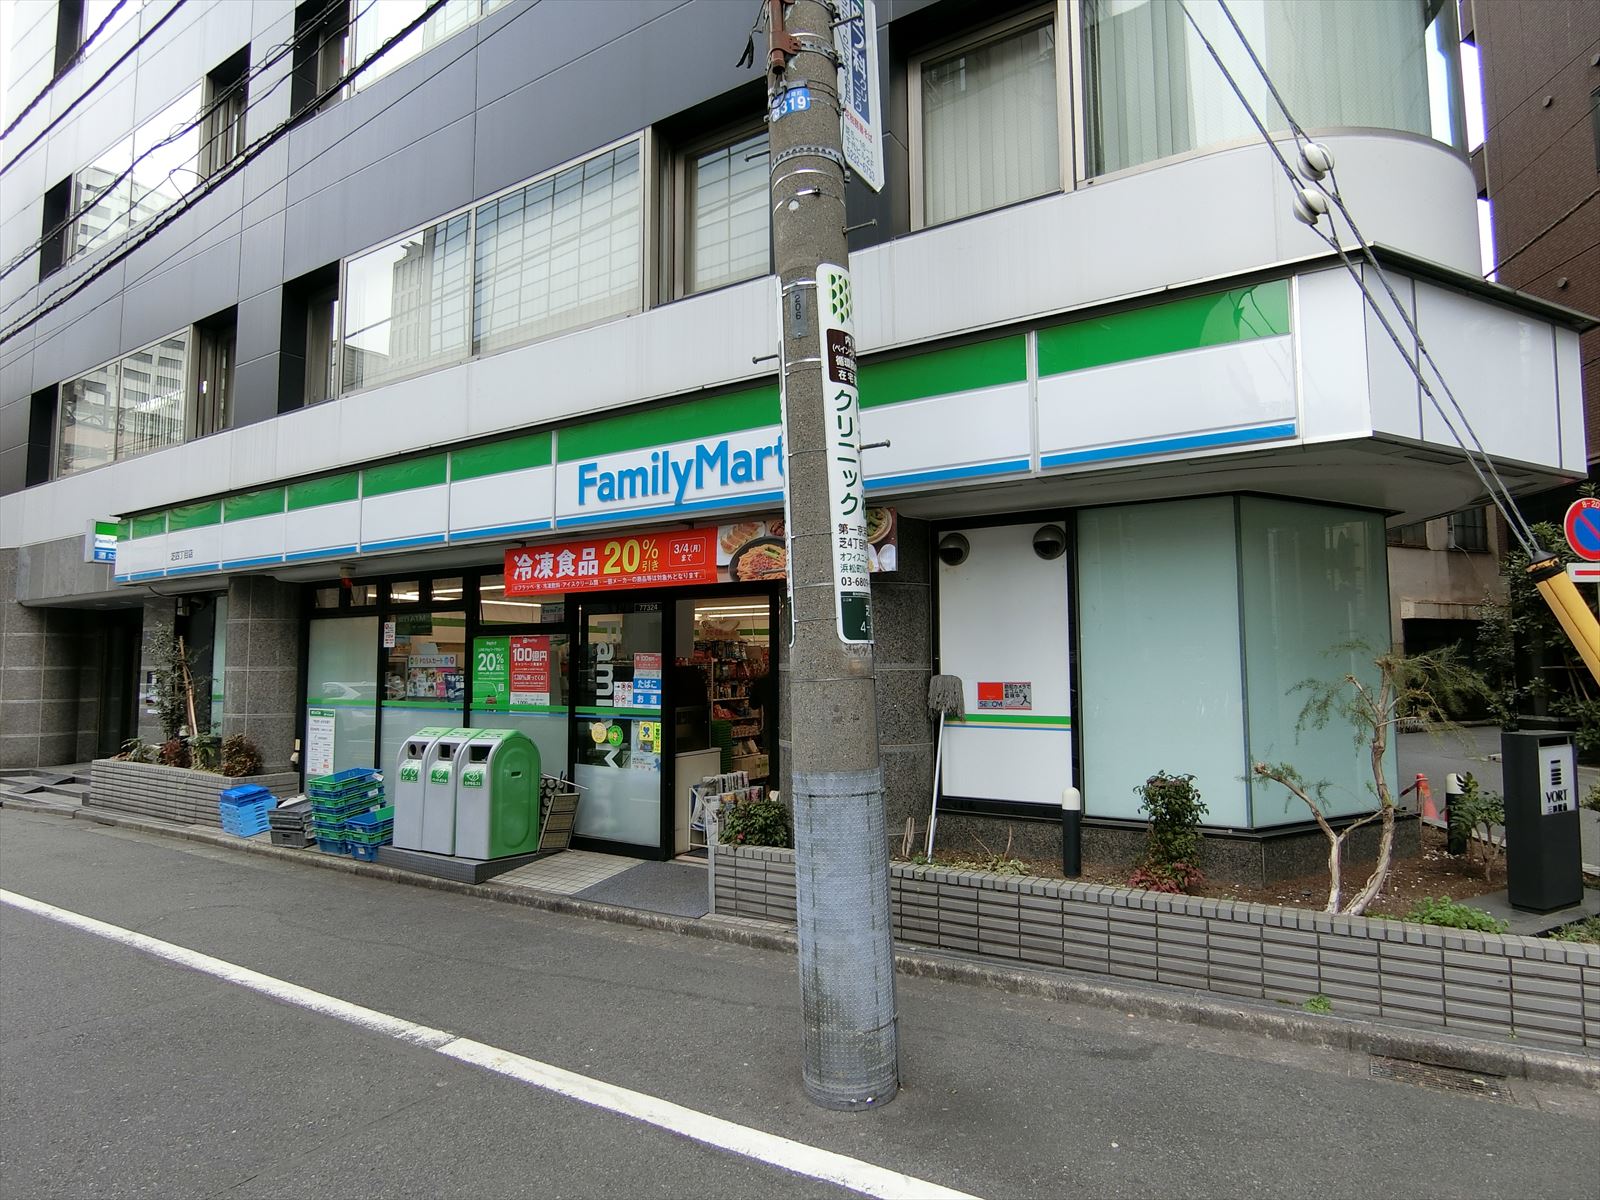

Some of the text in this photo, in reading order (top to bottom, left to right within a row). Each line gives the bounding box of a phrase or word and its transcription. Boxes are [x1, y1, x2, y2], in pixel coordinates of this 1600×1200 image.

[835, 389, 858, 516] クリニック
[513, 547, 598, 581] 冷凍食品
[681, 553, 692, 562] まで
[512, 648, 547, 662] 100億円
[637, 680, 657, 689] たばこ
[1545, 789, 1568, 803] VORT
